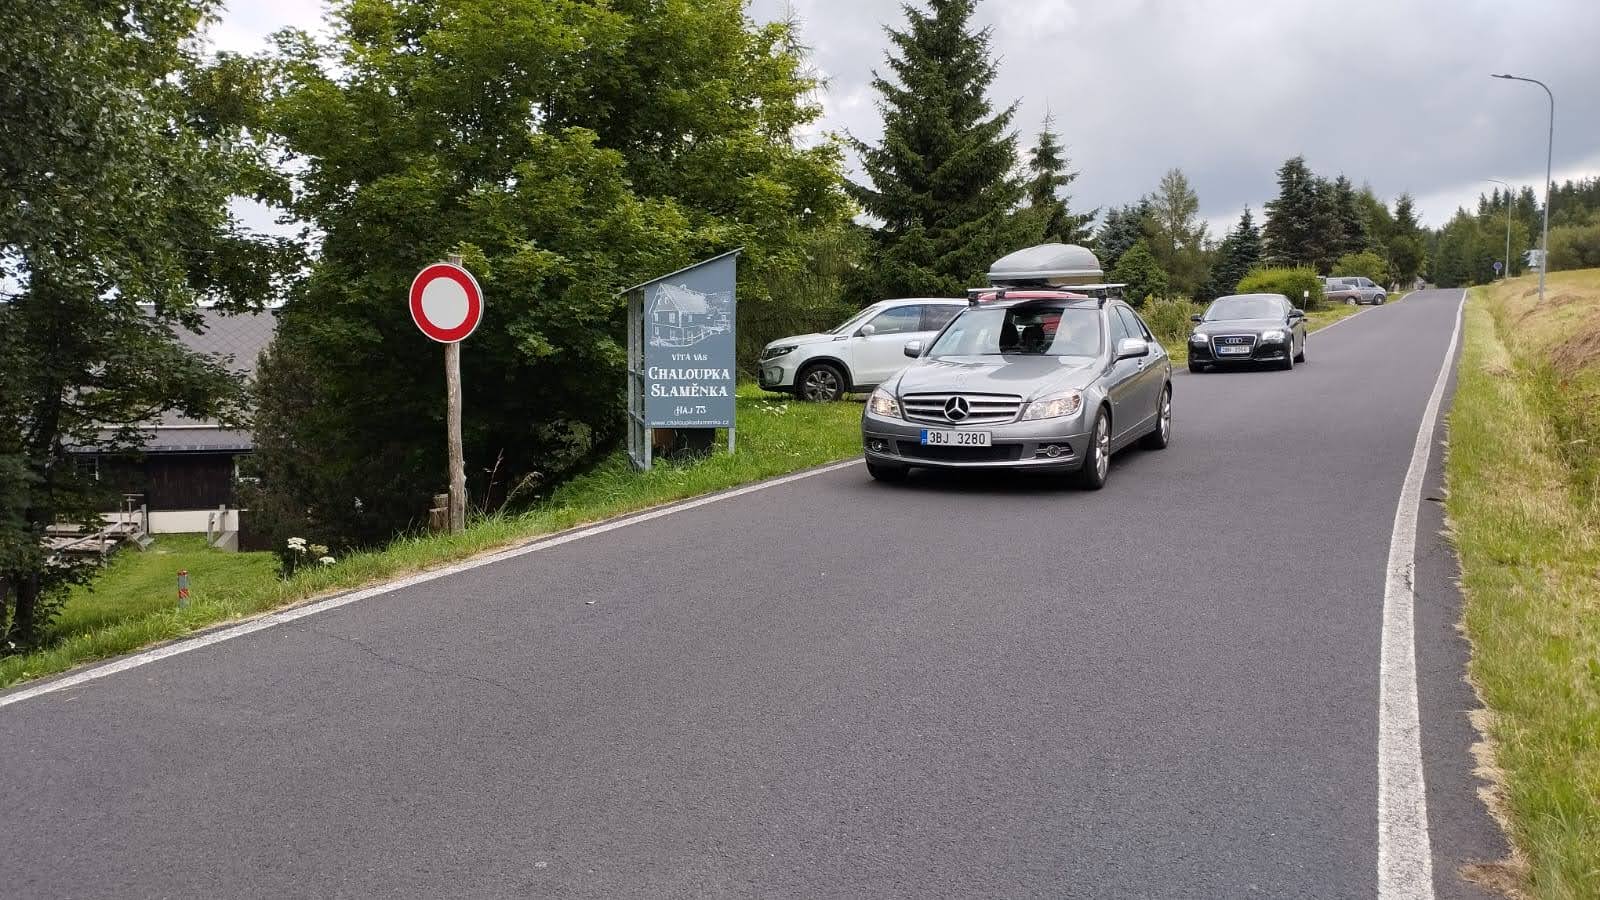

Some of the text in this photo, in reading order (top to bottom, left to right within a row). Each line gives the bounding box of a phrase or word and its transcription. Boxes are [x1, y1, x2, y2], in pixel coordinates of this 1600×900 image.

[648, 366, 730, 380] CHALOUPKA
[650, 382, 728, 397] SLAMĚNKA
[695, 405, 707, 414] 73
[929, 431, 949, 444] 3BJ
[957, 432, 986, 445] 3280
